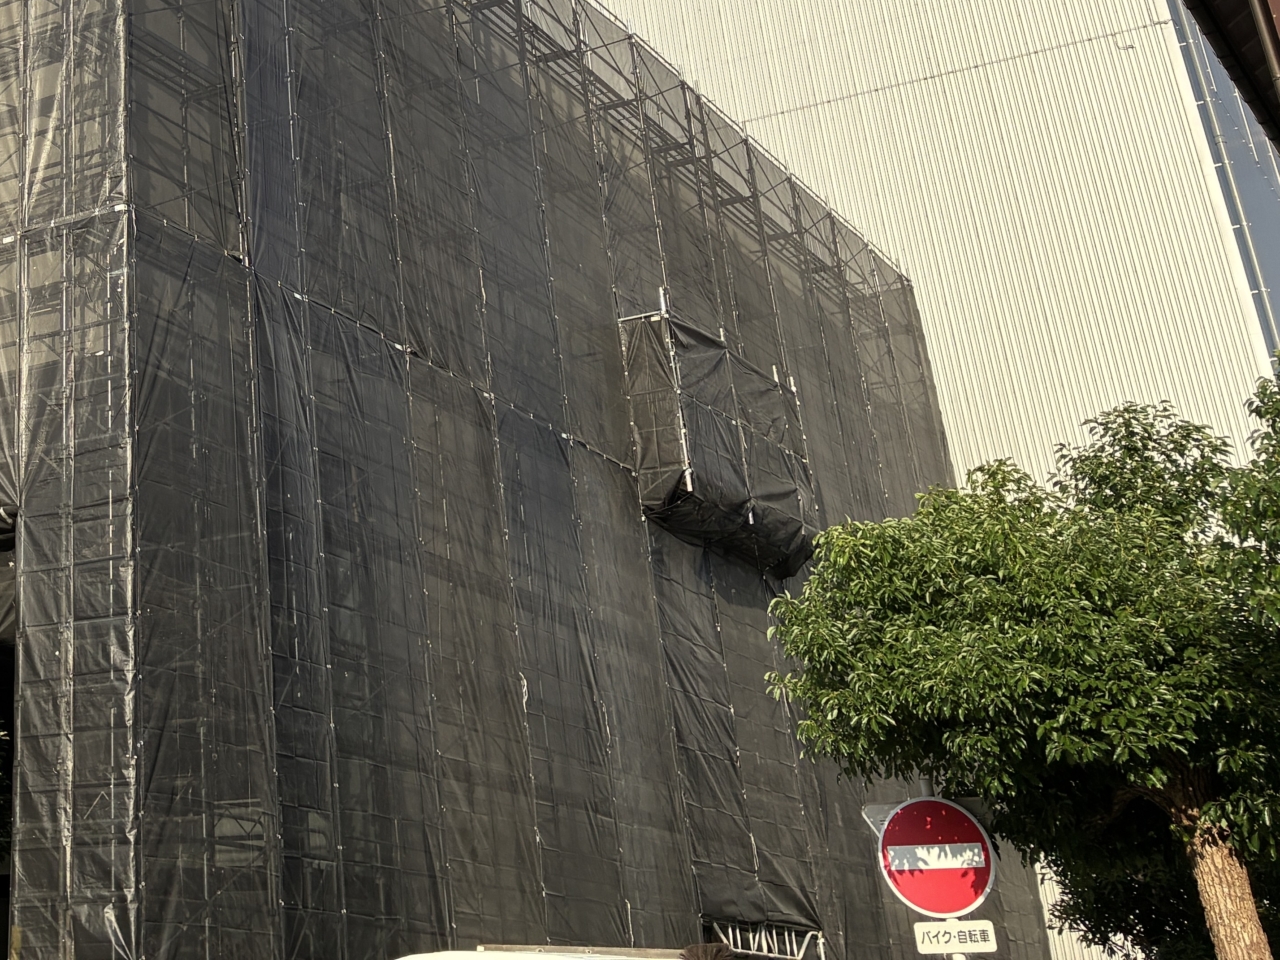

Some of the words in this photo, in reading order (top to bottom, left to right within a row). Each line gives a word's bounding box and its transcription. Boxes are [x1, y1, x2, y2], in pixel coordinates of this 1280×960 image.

[921, 929, 991, 945] バイク・自転車
